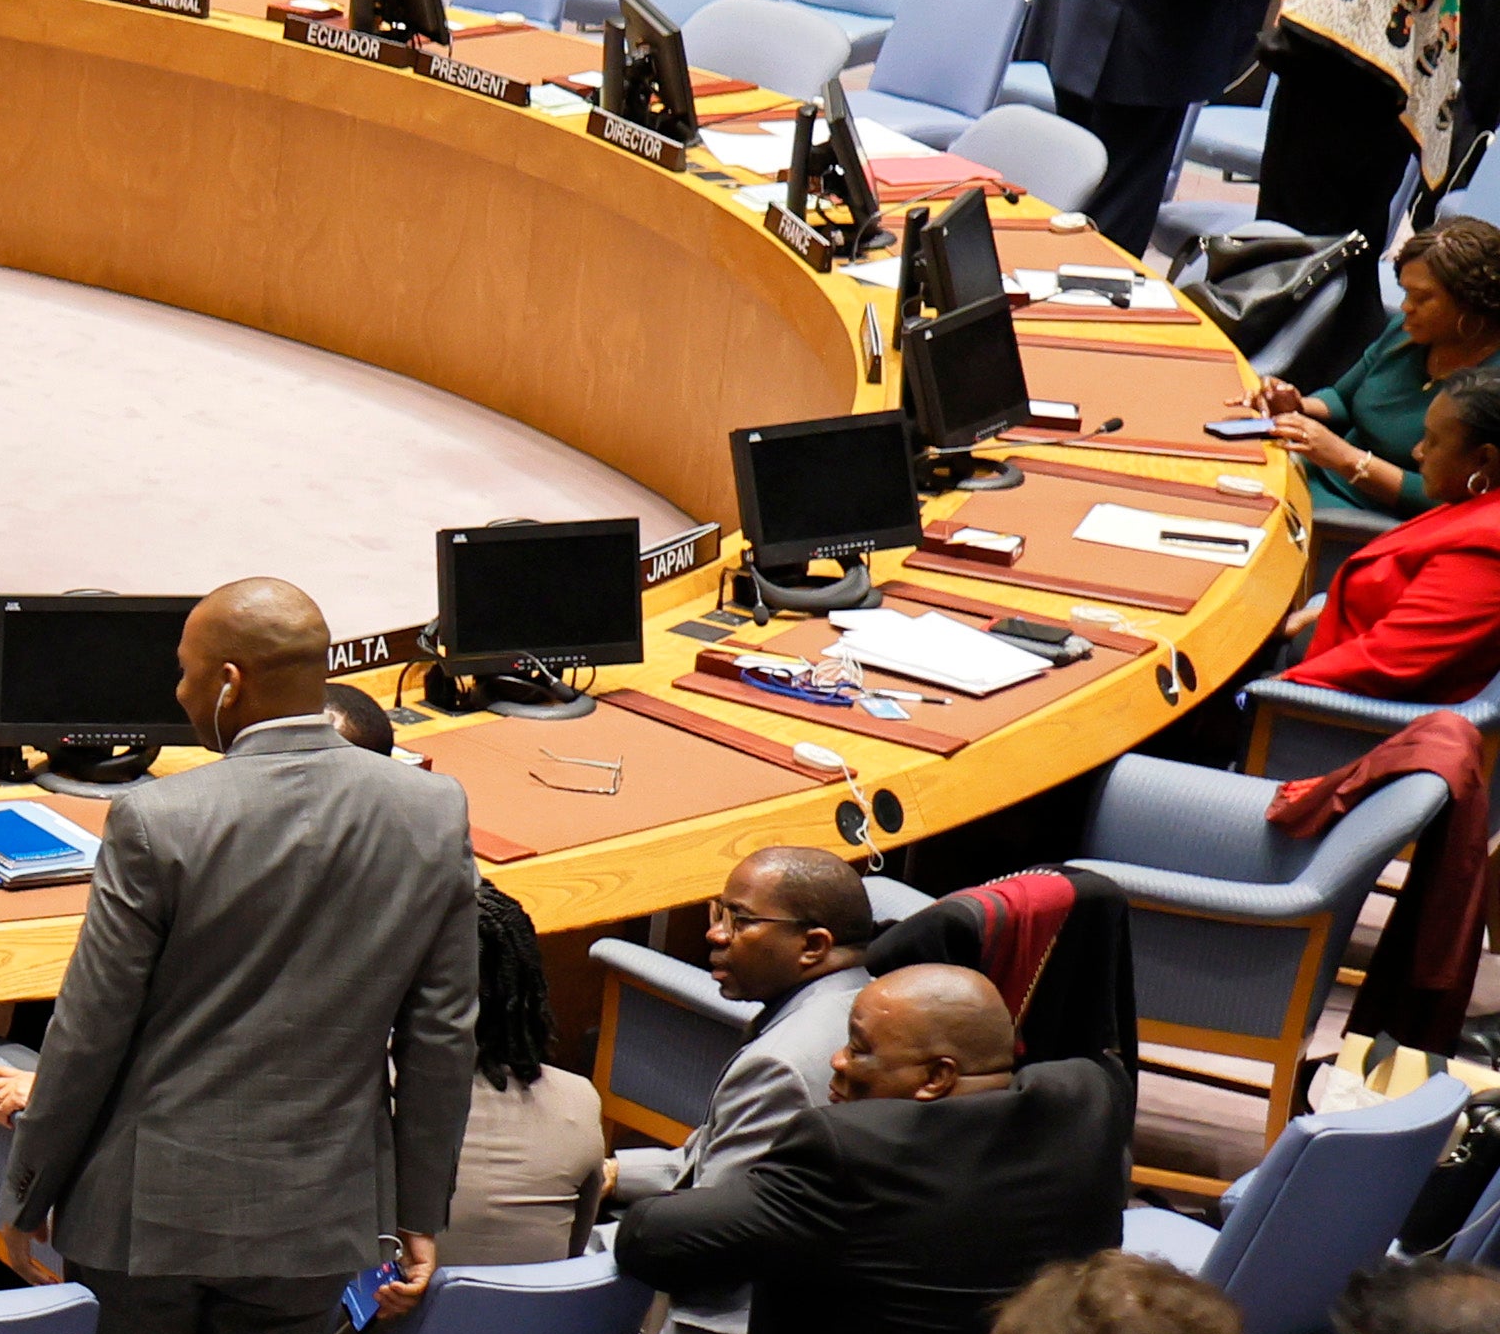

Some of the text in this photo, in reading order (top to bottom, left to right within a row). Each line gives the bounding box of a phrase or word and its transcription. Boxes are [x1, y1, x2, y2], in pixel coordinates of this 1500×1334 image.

[306, 23, 381, 60] ECUADOR
[429, 56, 510, 99] PRESIDENT
[603, 118, 662, 161] DIRECTOR
[646, 542, 695, 583] JAPAN
